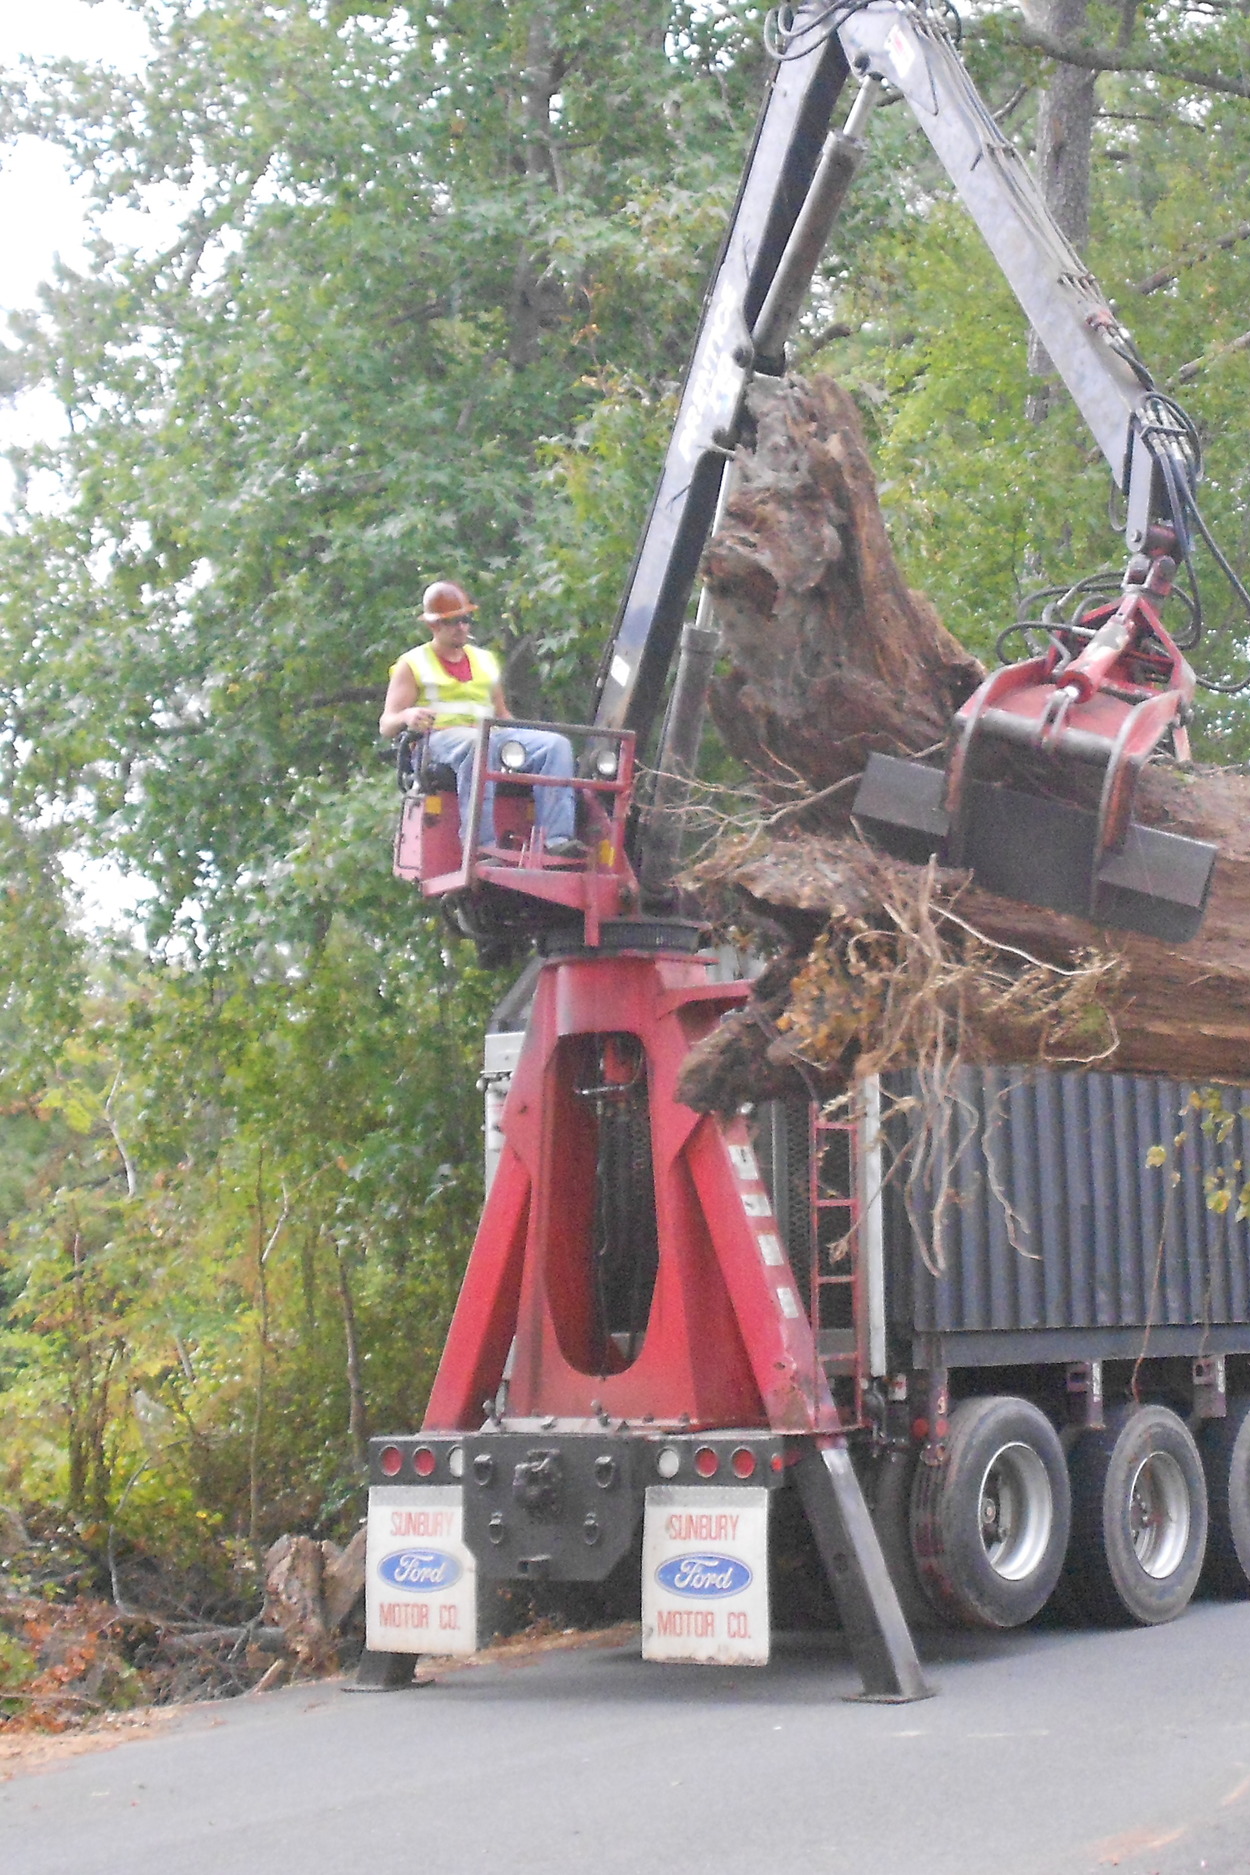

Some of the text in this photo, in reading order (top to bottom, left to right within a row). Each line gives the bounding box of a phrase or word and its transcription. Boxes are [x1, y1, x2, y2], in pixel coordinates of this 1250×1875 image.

[390, 1511, 455, 1537] SUNBURY
[669, 1514, 739, 1541] SUNBURY
[393, 1553, 449, 1583] Ford
[673, 1558, 734, 1590] Ford
[379, 1602, 461, 1631] MOTOR CO.
[657, 1610, 752, 1640] MOTOR CO.
